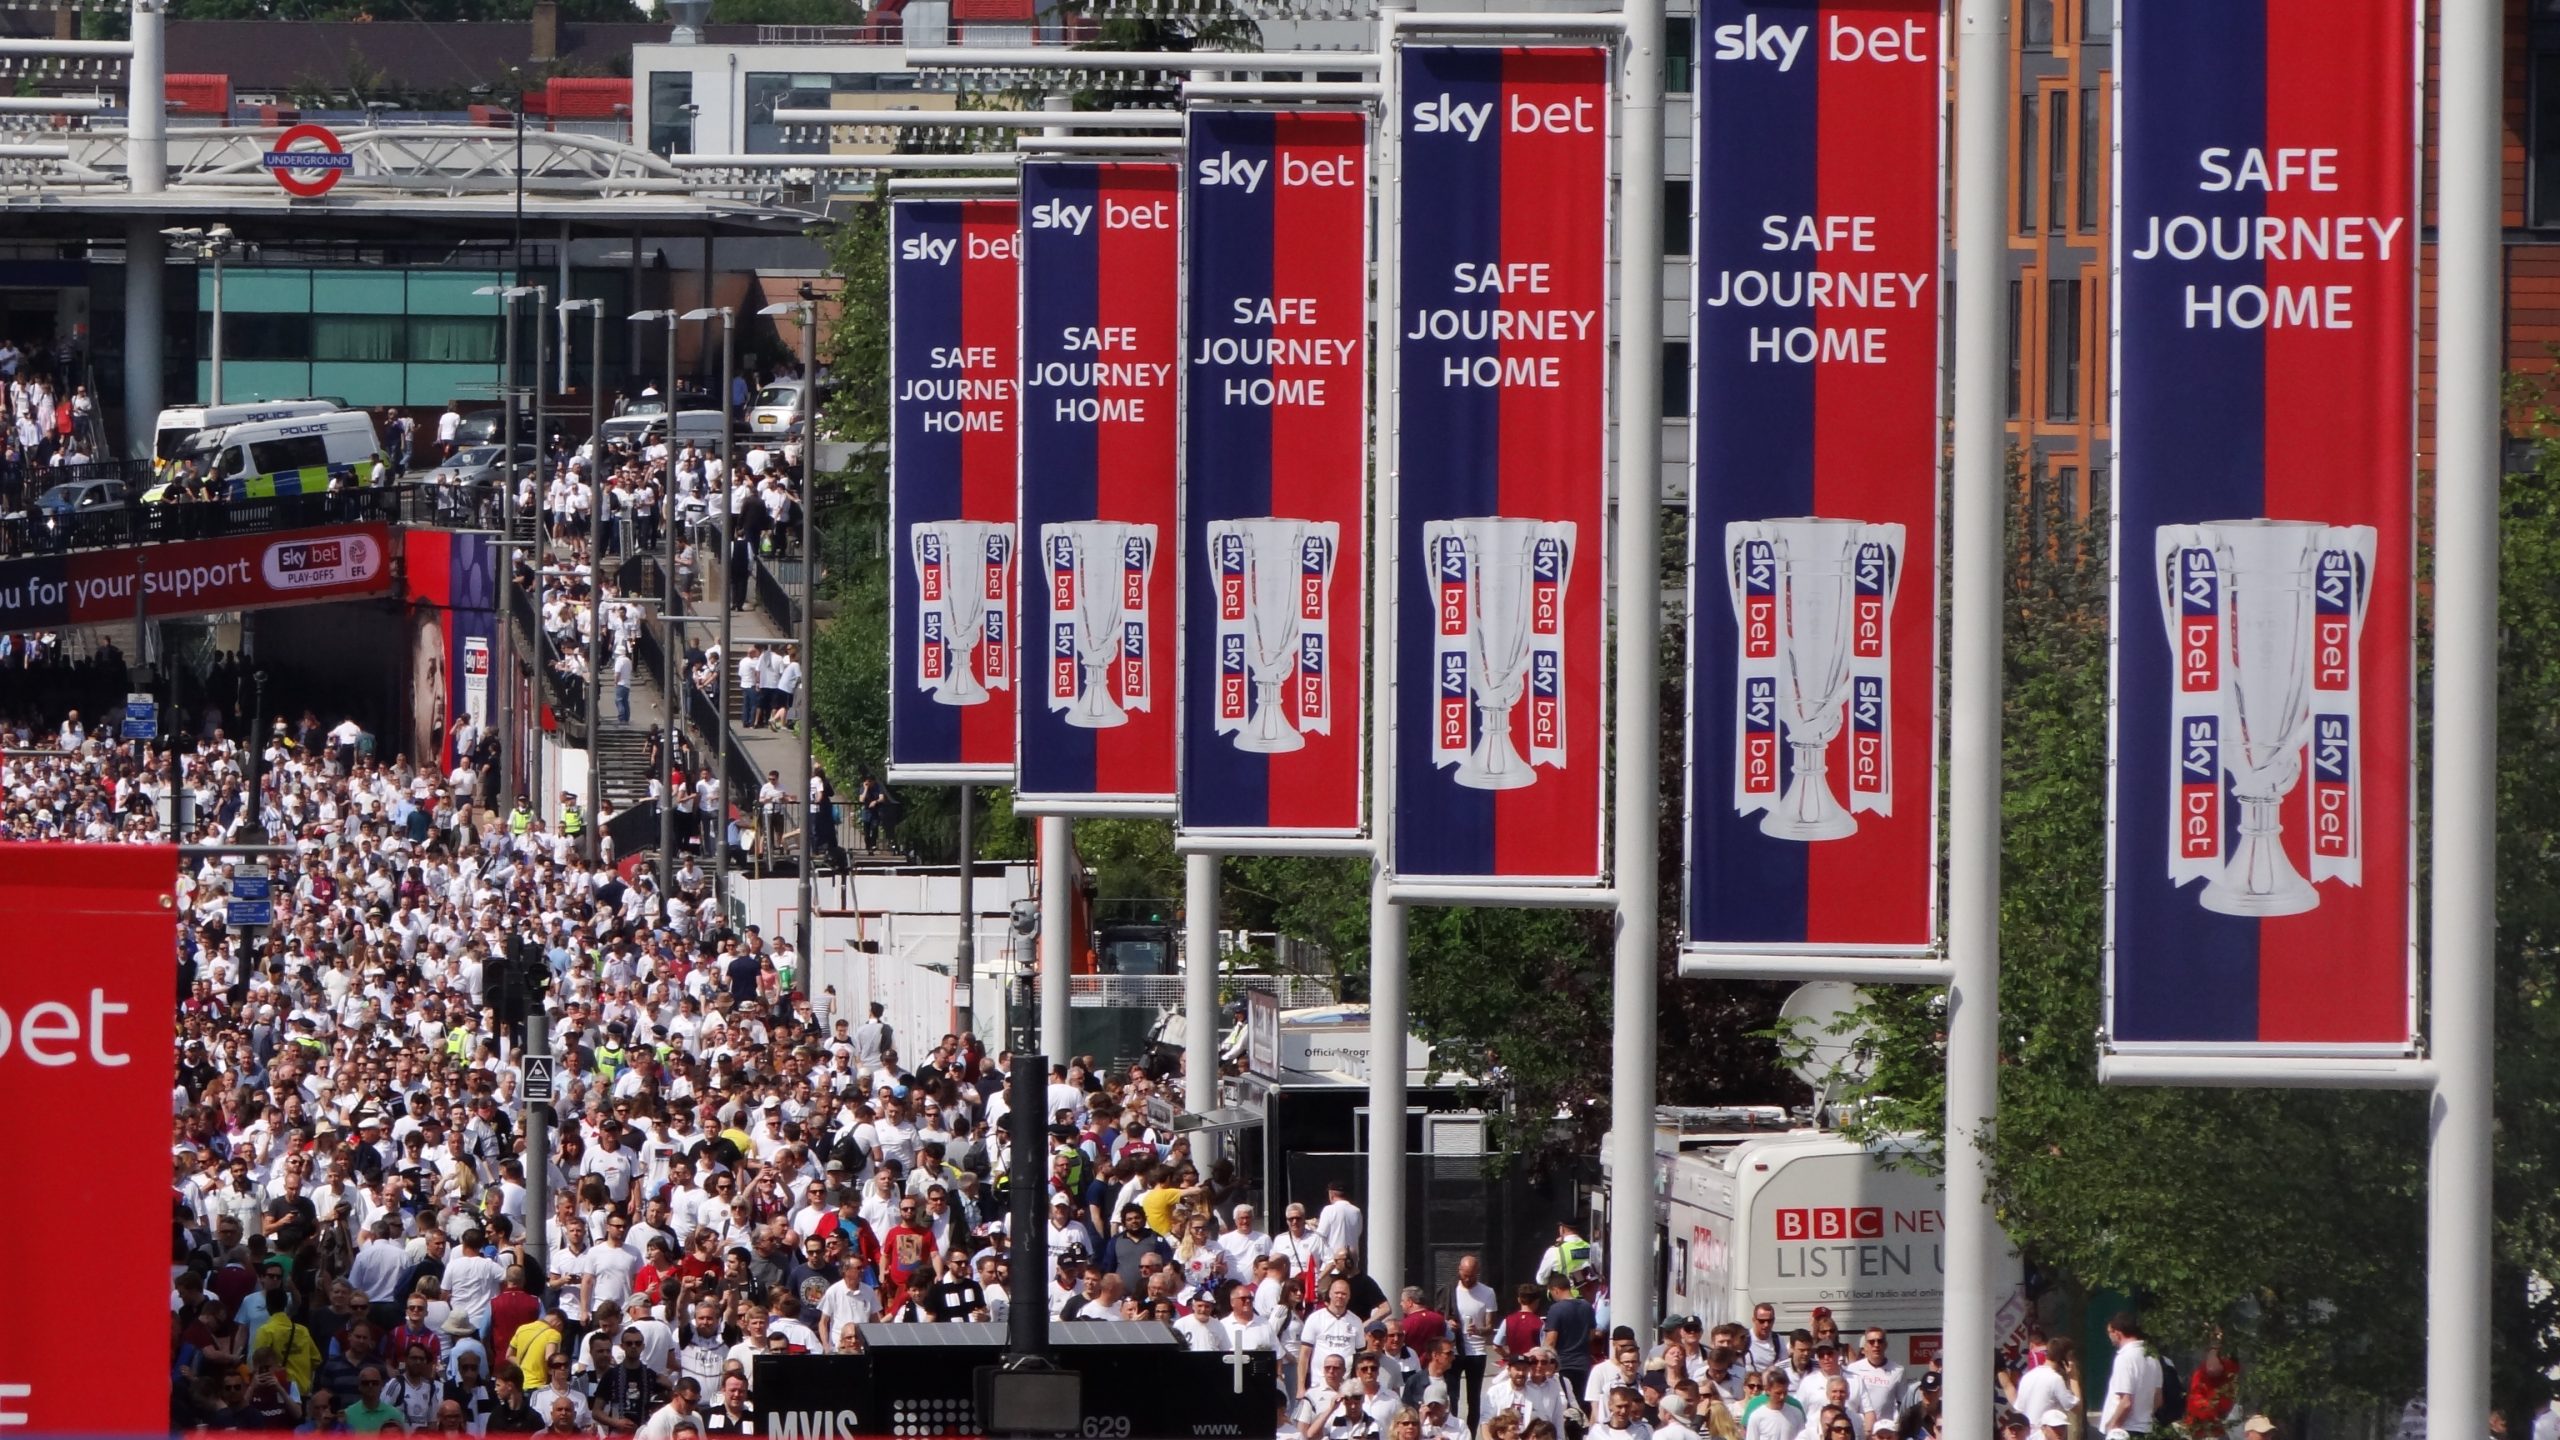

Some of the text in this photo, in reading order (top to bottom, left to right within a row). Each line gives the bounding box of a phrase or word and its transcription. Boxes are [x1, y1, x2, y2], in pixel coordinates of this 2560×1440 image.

[1714, 12, 1928, 73] sky bet
[1413, 92, 1594, 142] sky bet
[266, 155, 350, 166] UNDERGROUND
[1198, 150, 1355, 193] sky bet
[2198, 147, 2339, 193] SAFE
[1031, 198, 1170, 236] sky bet
[1761, 215, 1876, 253] SAFE
[2132, 215, 2405, 262] JOURNEY
[902, 232, 957, 266] sky
[1453, 262, 1551, 294] SAFE
[1707, 270, 1929, 309] JOURNEY
[1233, 297, 1317, 325] SAFE
[1407, 309, 1596, 342] JOURNEY
[2184, 284, 2353, 330] HOME
[930, 347, 996, 369] SAFE
[1062, 327, 1137, 351] SAFE
[1194, 337, 1357, 366] JOURNEY
[1749, 326, 1887, 364] HOME
[1028, 362, 1172, 387] JOURNEY
[1224, 378, 1326, 407] HOME
[1443, 356, 1561, 388] HOME
[246, 411, 294, 422] POLICE
[279, 423, 329, 436] POLICE
[923, 411, 1004, 432] HOME
[1055, 399, 1146, 423] HOME
[282, 546, 338, 568] sky bet
[288, 569, 335, 584] PLAY-OFFS
[351, 565, 367, 577] EFL
[925, 536, 941, 598] sky bet
[988, 535, 1002, 597] sky bet
[1056, 538, 1073, 607] sky bet
[1127, 538, 1143, 606] sky bet
[1223, 536, 1242, 616] sky bet
[1303, 536, 1323, 615] sky bet
[29, 576, 68, 606] for
[75, 573, 136, 608] your
[143, 556, 252, 597] support
[1442, 539, 1466, 632] sky bet
[1534, 538, 1558, 630] sky bet
[1747, 543, 1775, 652] sky bet
[1855, 543, 1882, 651] sky bet
[2182, 553, 2217, 685] sky bet
[2316, 554, 2351, 682] sky bet
[465, 651, 487, 672] sky bet
[926, 614, 941, 676] sky bet
[988, 614, 1002, 674] sky bet
[1056, 625, 1074, 694] sky bet
[1127, 625, 1142, 693] sky bet
[1223, 637, 1243, 715] sky bet
[1303, 637, 1321, 713] sky bet
[1443, 655, 1466, 746] sky bet
[1534, 655, 1557, 744] sky bet
[1747, 682, 1775, 788] sky bet
[1855, 681, 1882, 786] sky bet
[2183, 721, 2217, 852] sky bet
[2316, 720, 2348, 849] sky bet
[1783, 1211, 1878, 1237] BBC
[1777, 1244, 1911, 1278] LISTEN
[1820, 1291, 1834, 1299] On
[1853, 1290, 1873, 1299] local
[1876, 1290, 1899, 1299] radio
[1901, 1289, 1917, 1299] and
[1192, 1424, 1243, 1436] www.
